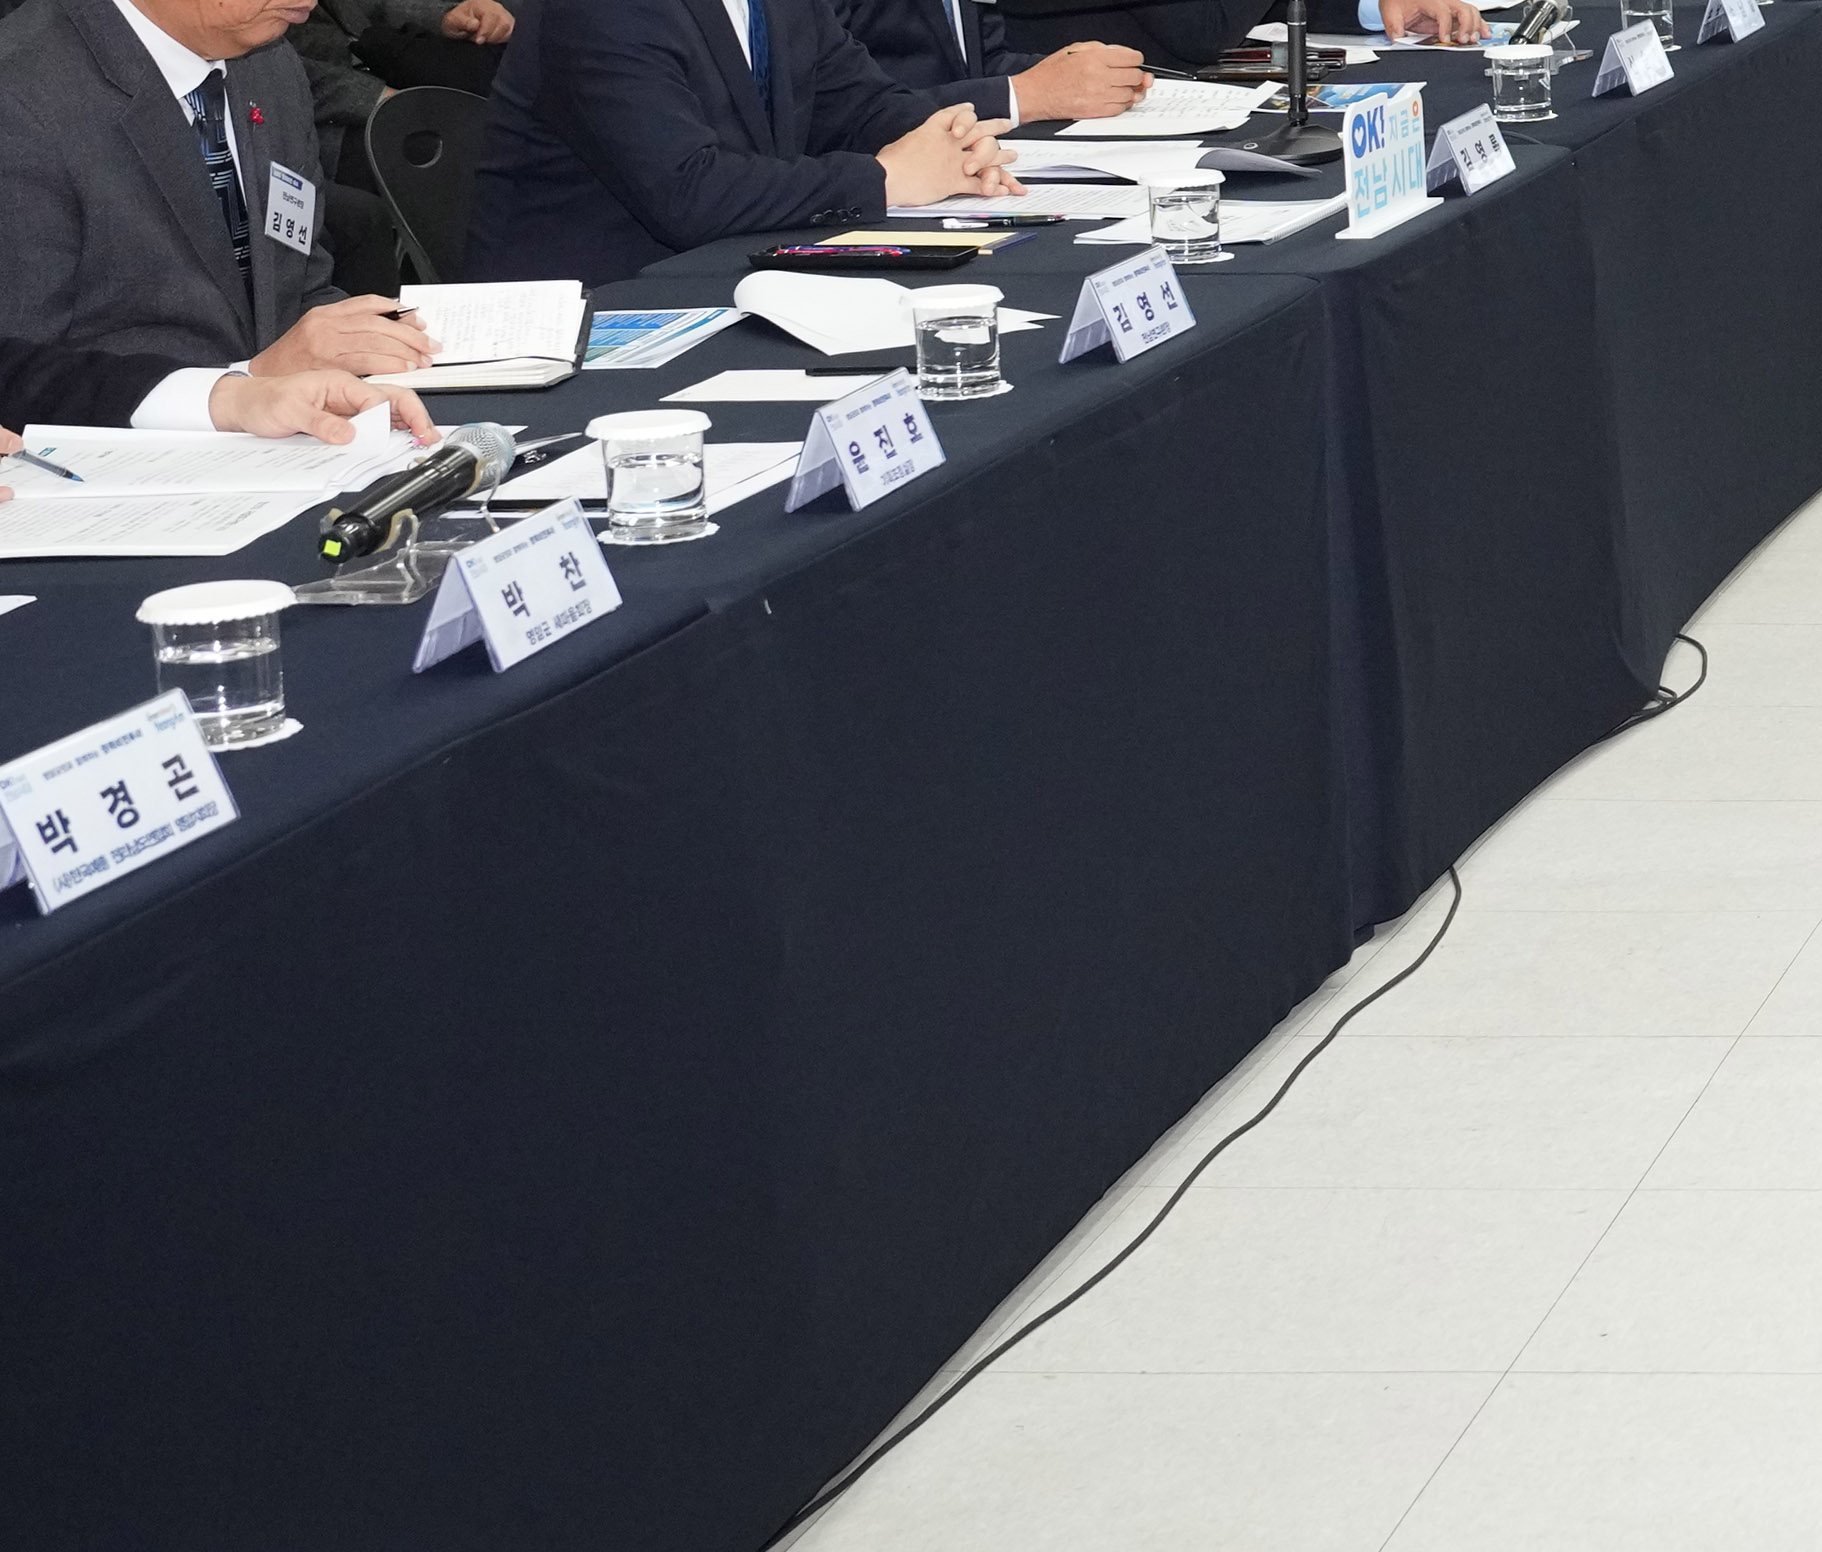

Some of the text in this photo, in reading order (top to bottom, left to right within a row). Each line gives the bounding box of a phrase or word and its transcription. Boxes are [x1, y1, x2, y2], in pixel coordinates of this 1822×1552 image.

[1352, 100, 1421, 159] OK! 지금은
[1354, 141, 1424, 219] 전남시대
